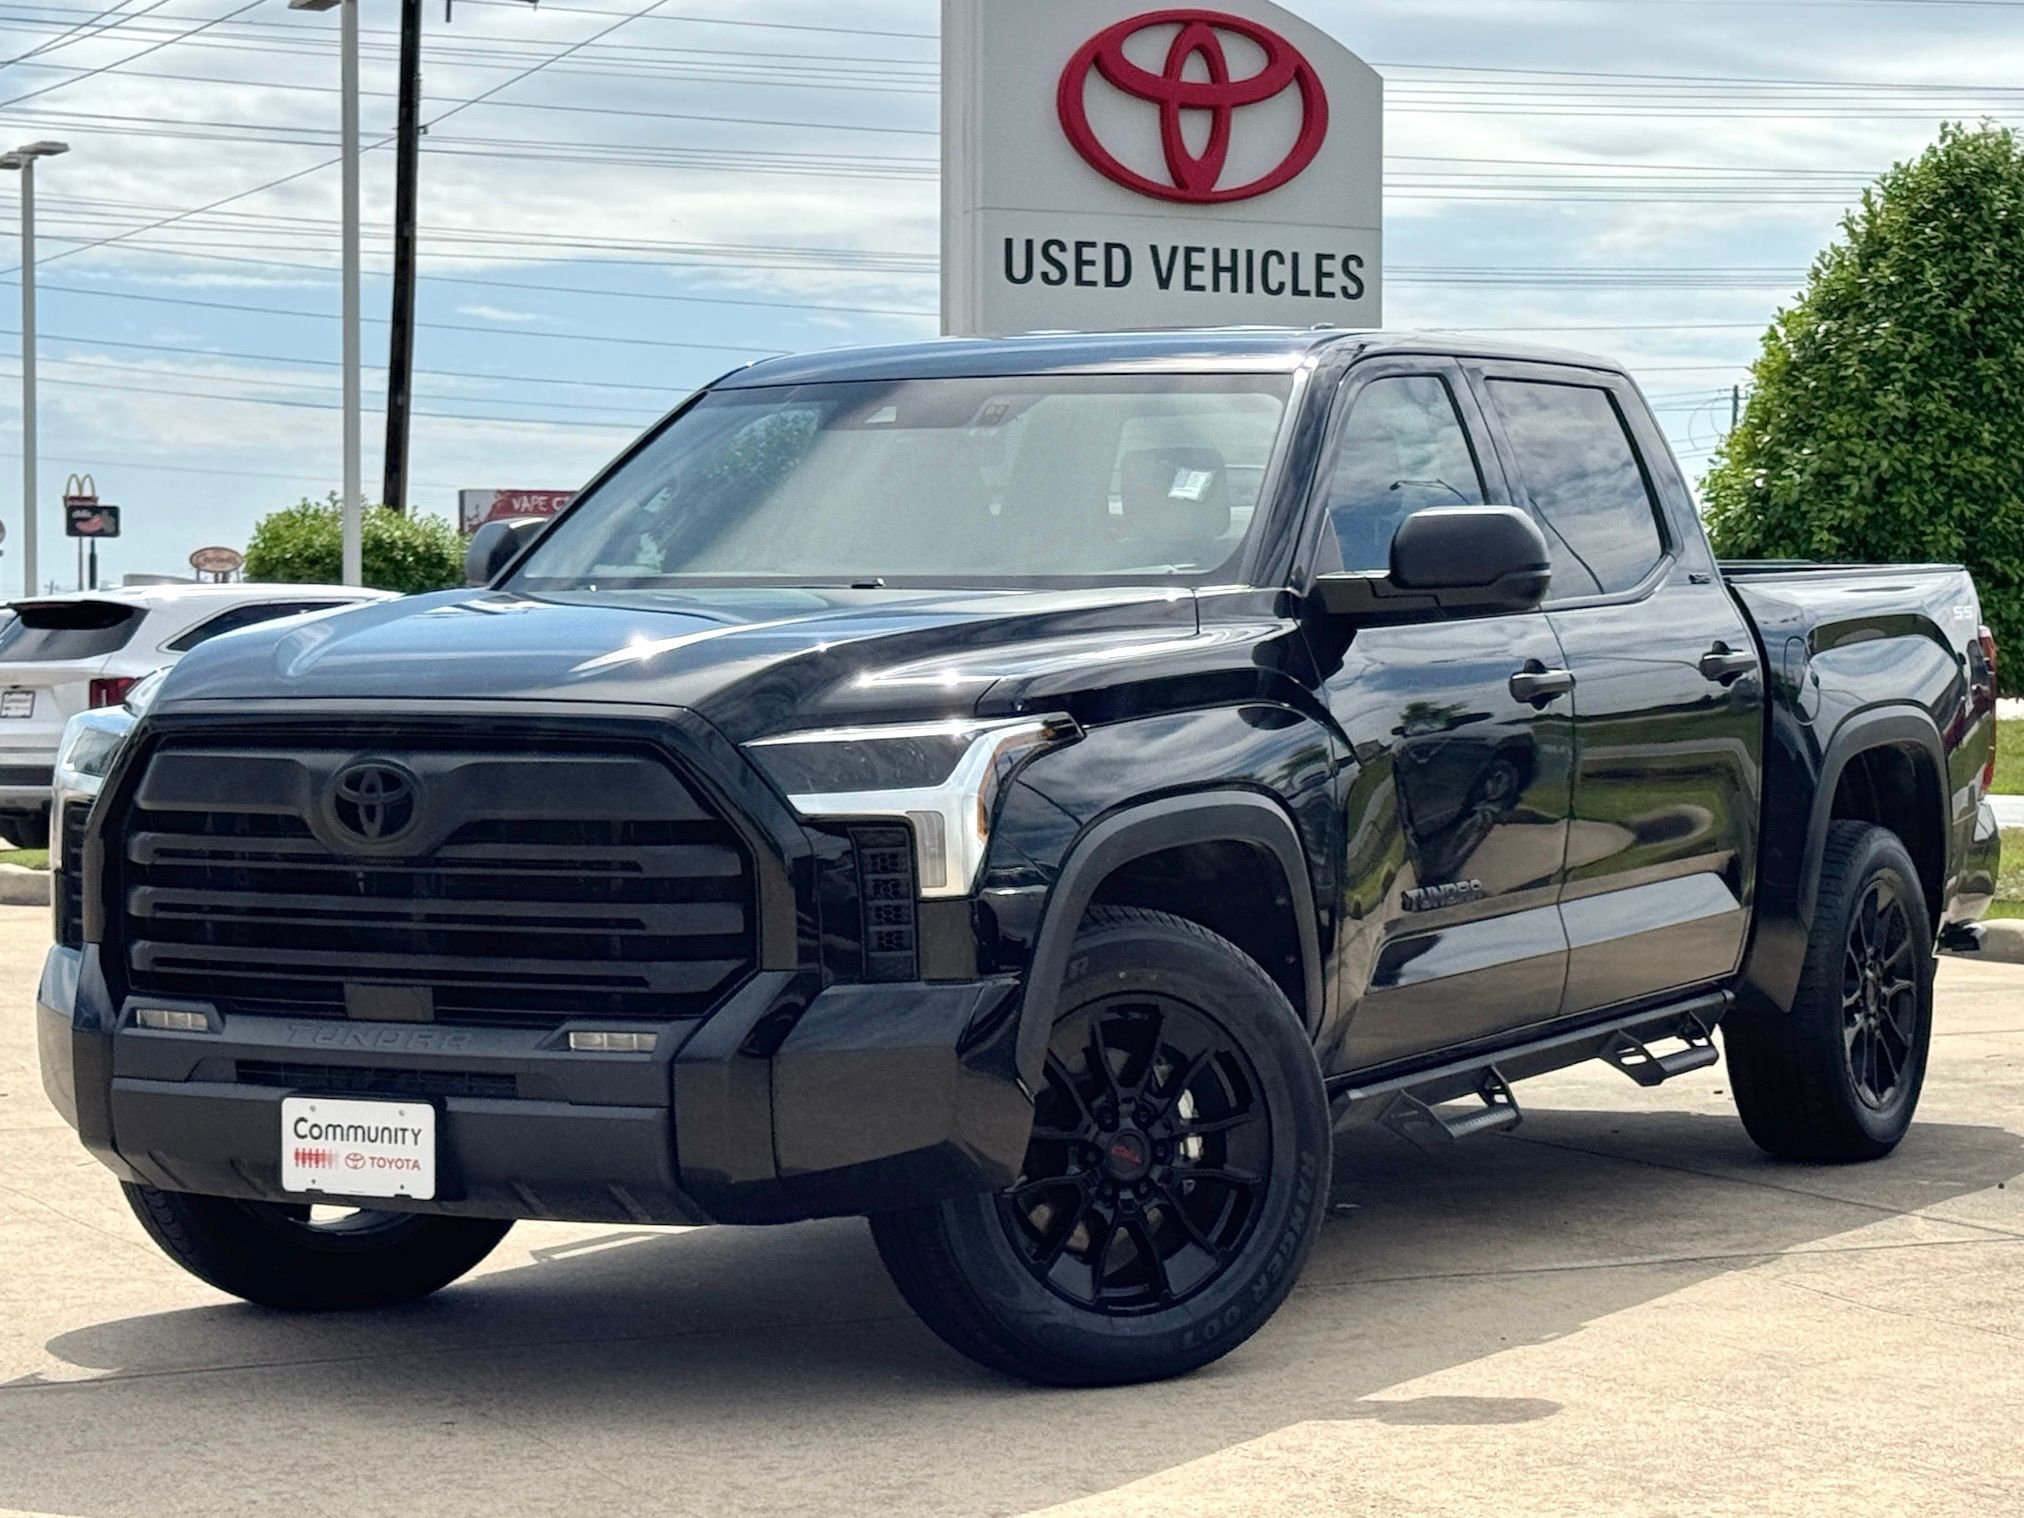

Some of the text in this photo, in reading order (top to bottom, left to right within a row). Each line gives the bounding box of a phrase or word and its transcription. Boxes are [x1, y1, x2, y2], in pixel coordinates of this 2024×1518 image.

[1004, 237, 1364, 300] USED VEHICLES
[512, 495, 548, 512] VAPE
[287, 1024, 476, 1050] TUNDRA
[369, 1155, 421, 1171] TOYOTA
